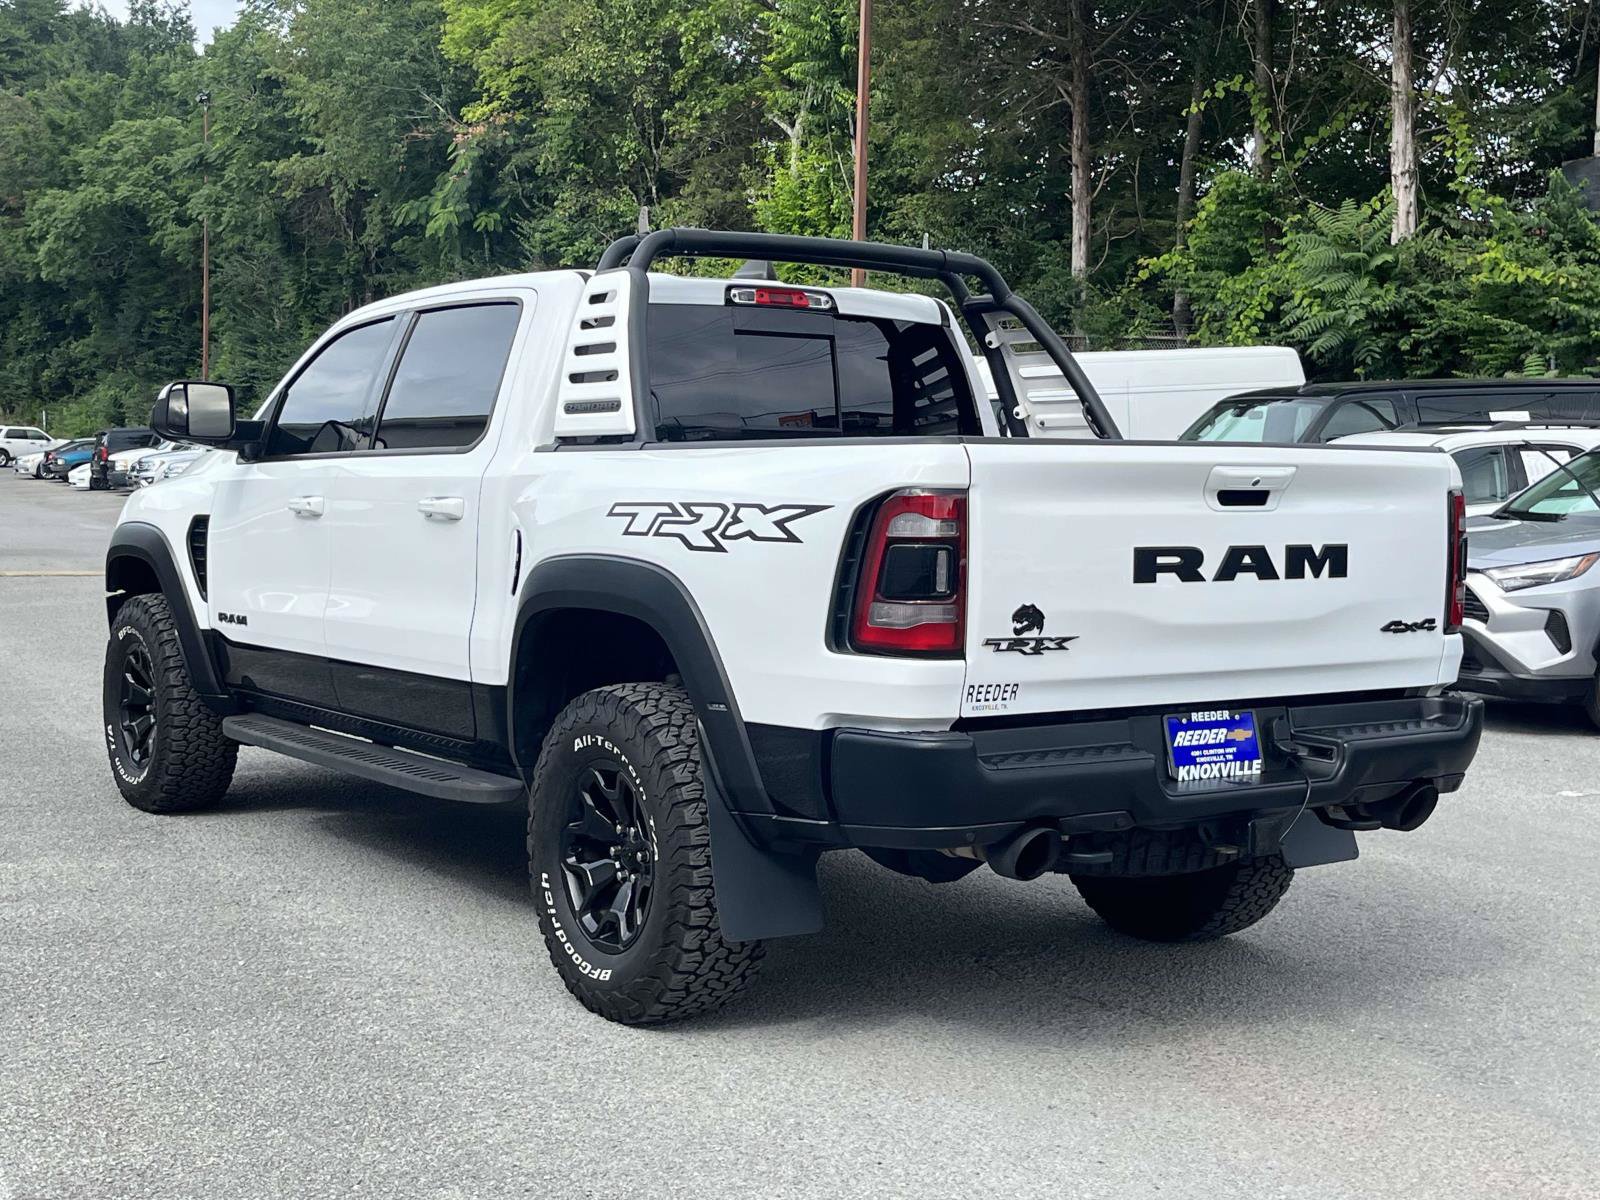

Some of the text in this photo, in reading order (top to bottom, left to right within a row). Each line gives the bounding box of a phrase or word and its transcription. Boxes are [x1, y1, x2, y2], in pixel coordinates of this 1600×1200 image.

[606, 502, 836, 553] TRX
[1133, 544, 1348, 584] RAM
[218, 612, 247, 626] RAM
[981, 636, 1080, 655] TRX
[966, 683, 1020, 703] REEDER
[1191, 710, 1230, 722] REEDER
[1173, 728, 1228, 747] REEDER
[574, 735, 647, 800] All-Terrain
[1178, 759, 1262, 781] KNOXVILLE
[541, 872, 612, 981] BFGoodrich
